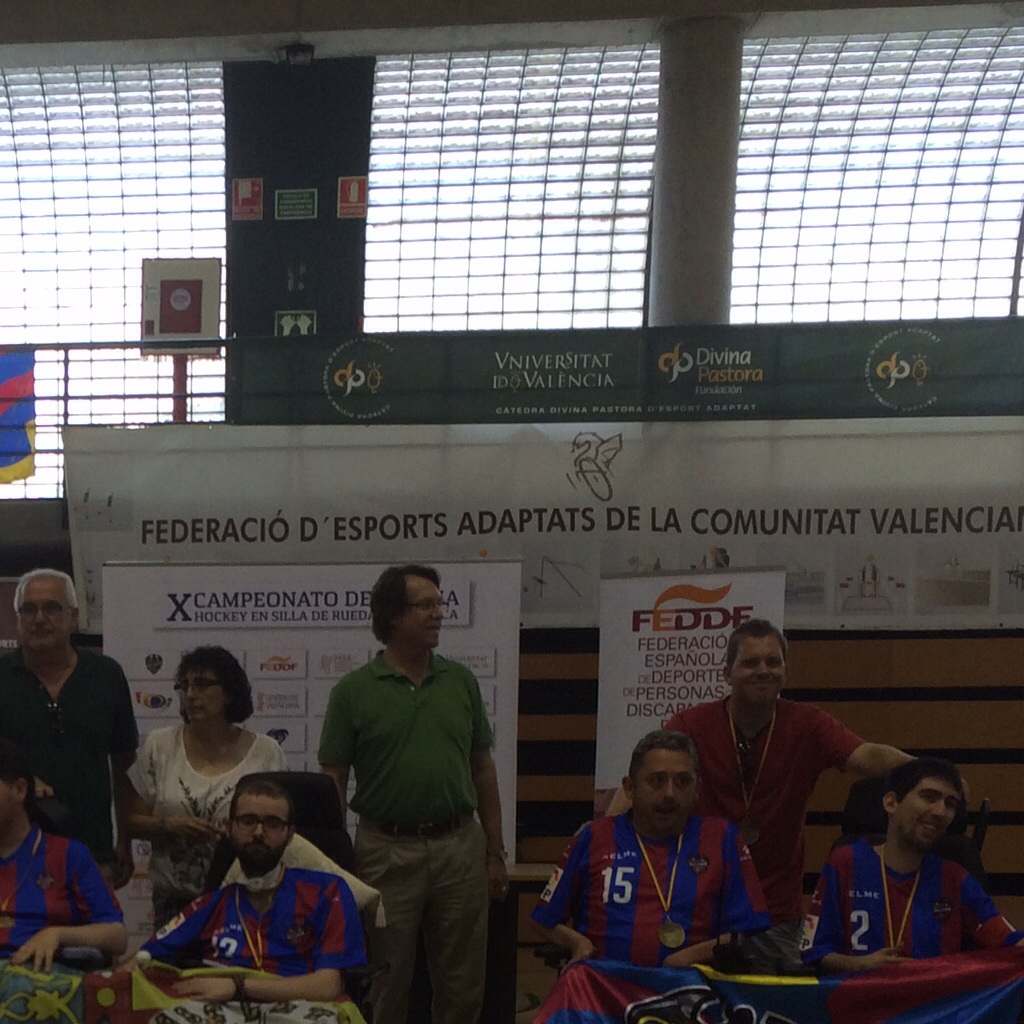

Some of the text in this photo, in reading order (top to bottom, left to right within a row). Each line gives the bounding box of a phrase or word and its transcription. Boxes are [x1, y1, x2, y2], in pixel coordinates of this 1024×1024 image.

[696, 347, 752, 366] Divina
[698, 366, 764, 383] Pastora
[549, 406, 588, 414] DIVINA
[592, 405, 643, 414] PASTORA
[705, 403, 757, 412] ADAPTAT
[141, 510, 290, 544] FEDERACIÓ
[457, 507, 596, 536] ADAPTATS
[606, 506, 641, 531] DE
[651, 506, 682, 533] LA
[690, 508, 861, 535] COMUNITAT
[167, 593, 193, 622] X
[193, 591, 339, 609] CAMPEONATO
[194, 611, 248, 622] HOCKEY
[251, 611, 269, 622] EN
[272, 610, 308, 622] SILLA
[311, 610, 329, 621] DE
[632, 606, 753, 632] FEDDF
[638, 633, 727, 651] FEDERACIÓ
[651, 668, 726, 684] DEPORTE
[636, 685, 725, 700] PERSONAS
[601, 866, 635, 904] 15
[850, 909, 870, 951] 2
